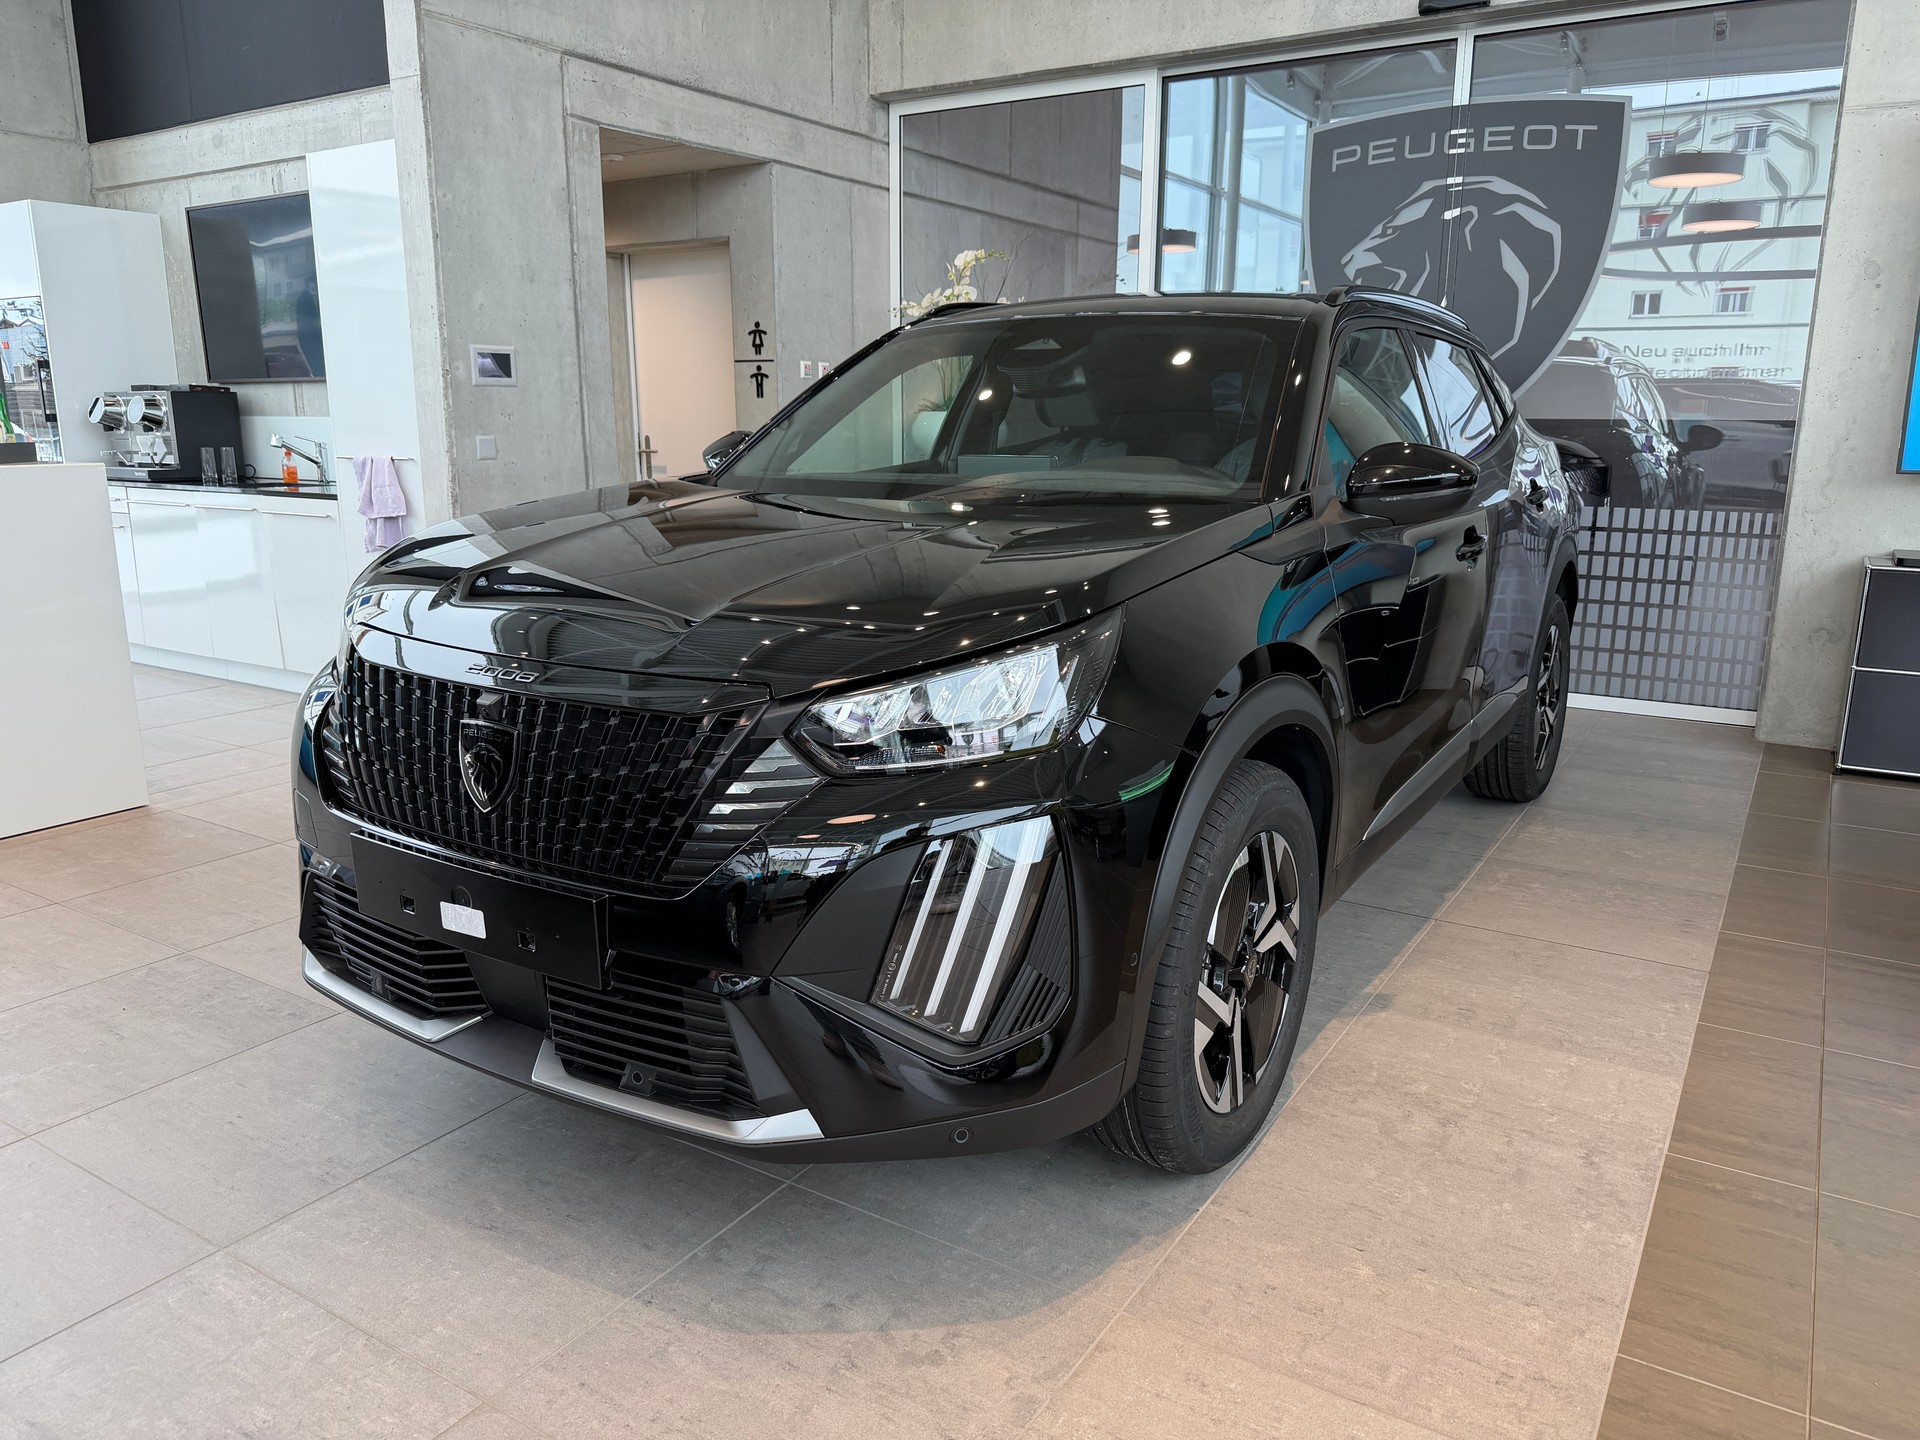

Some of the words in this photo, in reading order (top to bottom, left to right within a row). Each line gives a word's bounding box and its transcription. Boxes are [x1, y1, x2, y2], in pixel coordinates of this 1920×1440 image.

[1331, 124, 1598, 172] PEUGEOT
[1624, 345, 1667, 358] Neu
[465, 664, 540, 683] 2008
[463, 728, 510, 743] PEUGEOT
